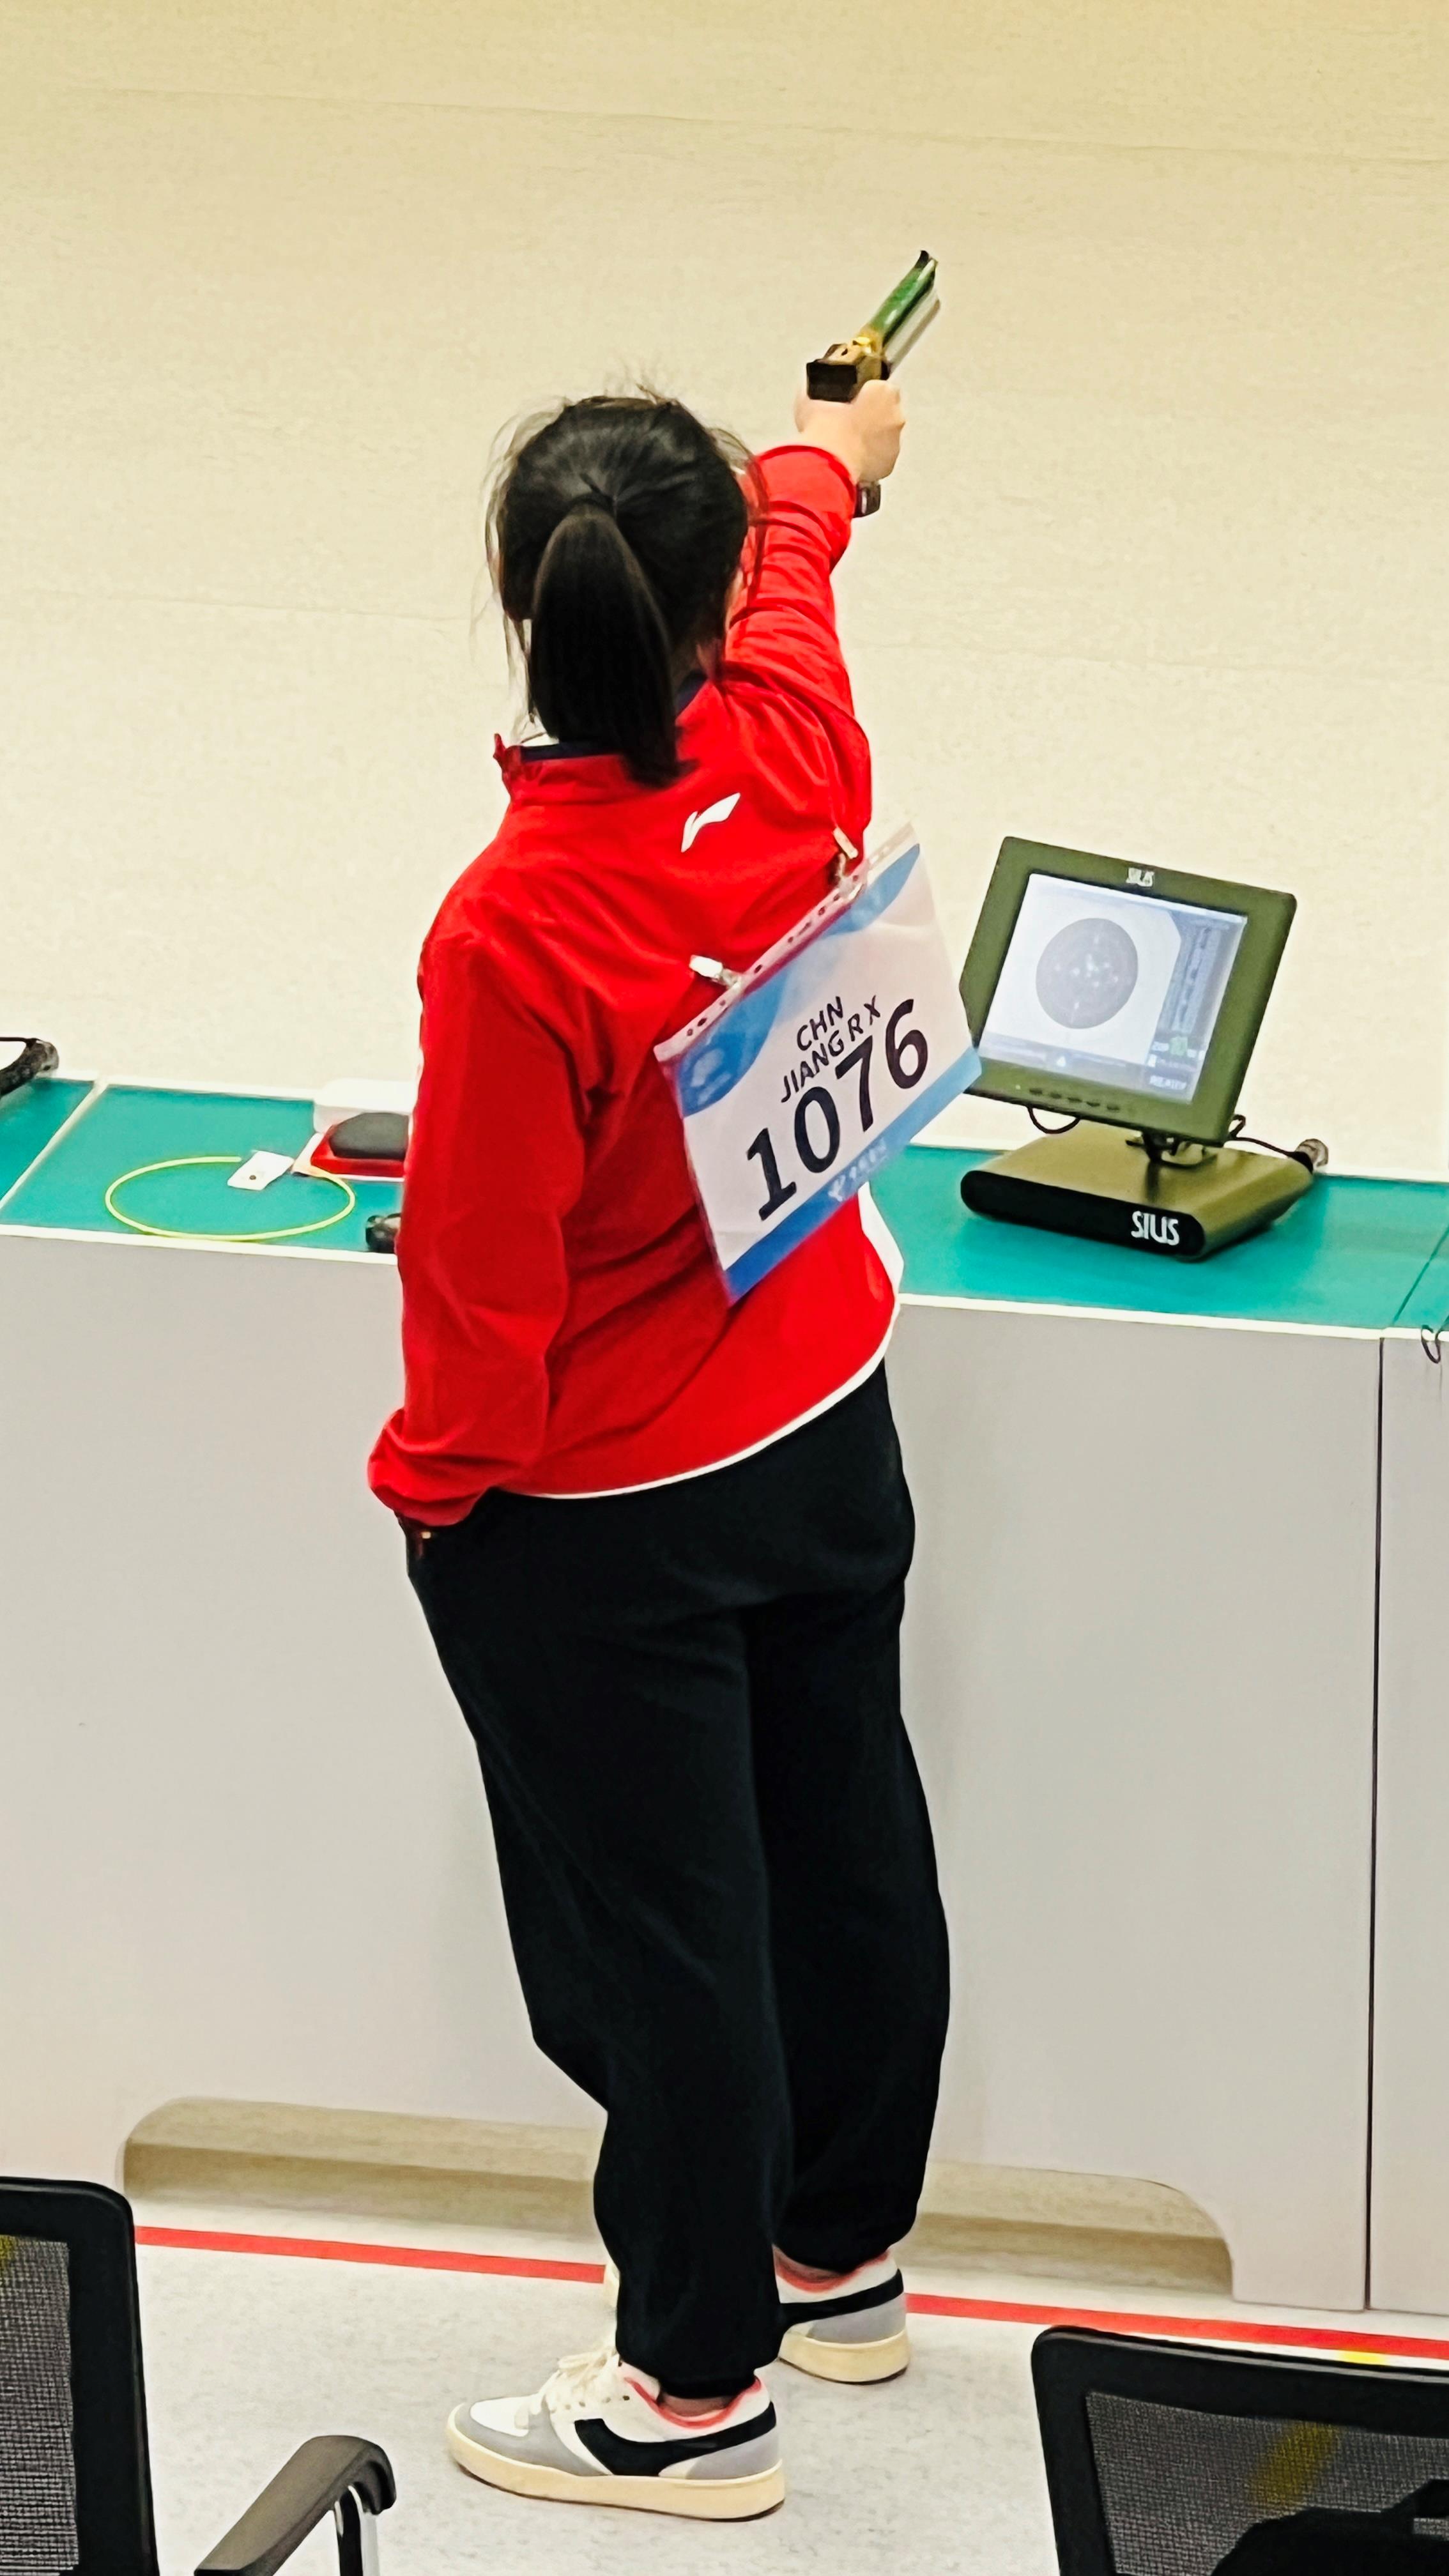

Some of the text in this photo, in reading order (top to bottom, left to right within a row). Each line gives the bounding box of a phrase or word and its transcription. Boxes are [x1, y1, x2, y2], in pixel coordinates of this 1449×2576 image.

[797, 995, 843, 1051] CHN
[781, 1029, 845, 1103] JIANG
[747, 998, 929, 1222] 1076
[1130, 1210, 1180, 1246] SIUS
